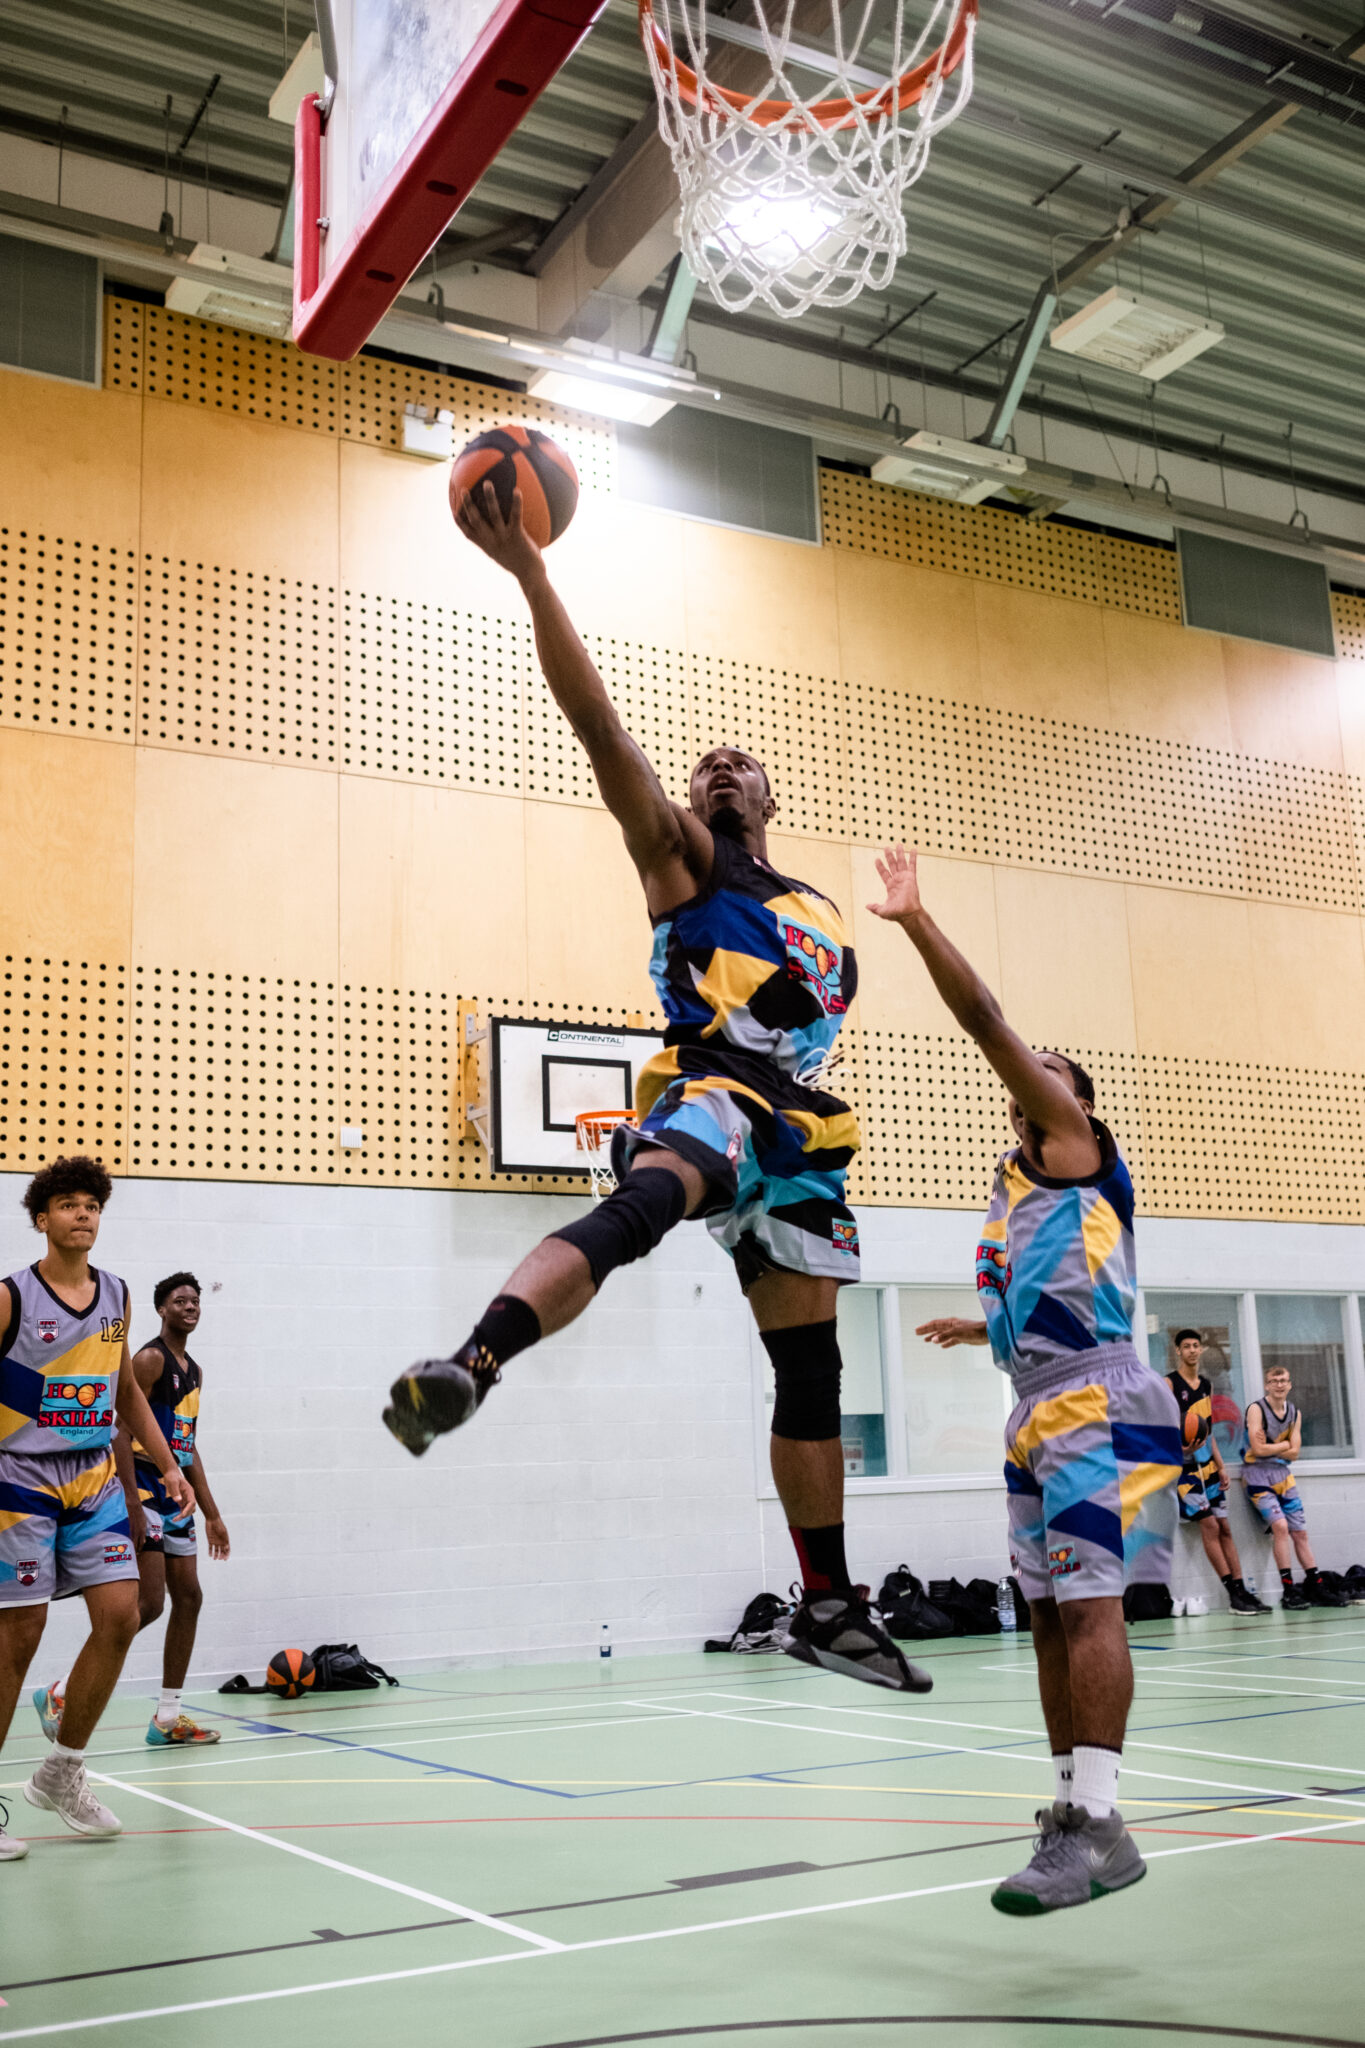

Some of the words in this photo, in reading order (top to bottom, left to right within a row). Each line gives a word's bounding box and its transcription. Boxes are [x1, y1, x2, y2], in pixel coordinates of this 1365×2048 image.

[548, 1030, 622, 1044] CONTINENTAL
[100, 1316, 124, 1342] 12
[45, 1382, 107, 1408] HOOP
[37, 1410, 113, 1428] SKILLS
[60, 1427, 94, 1436] England
